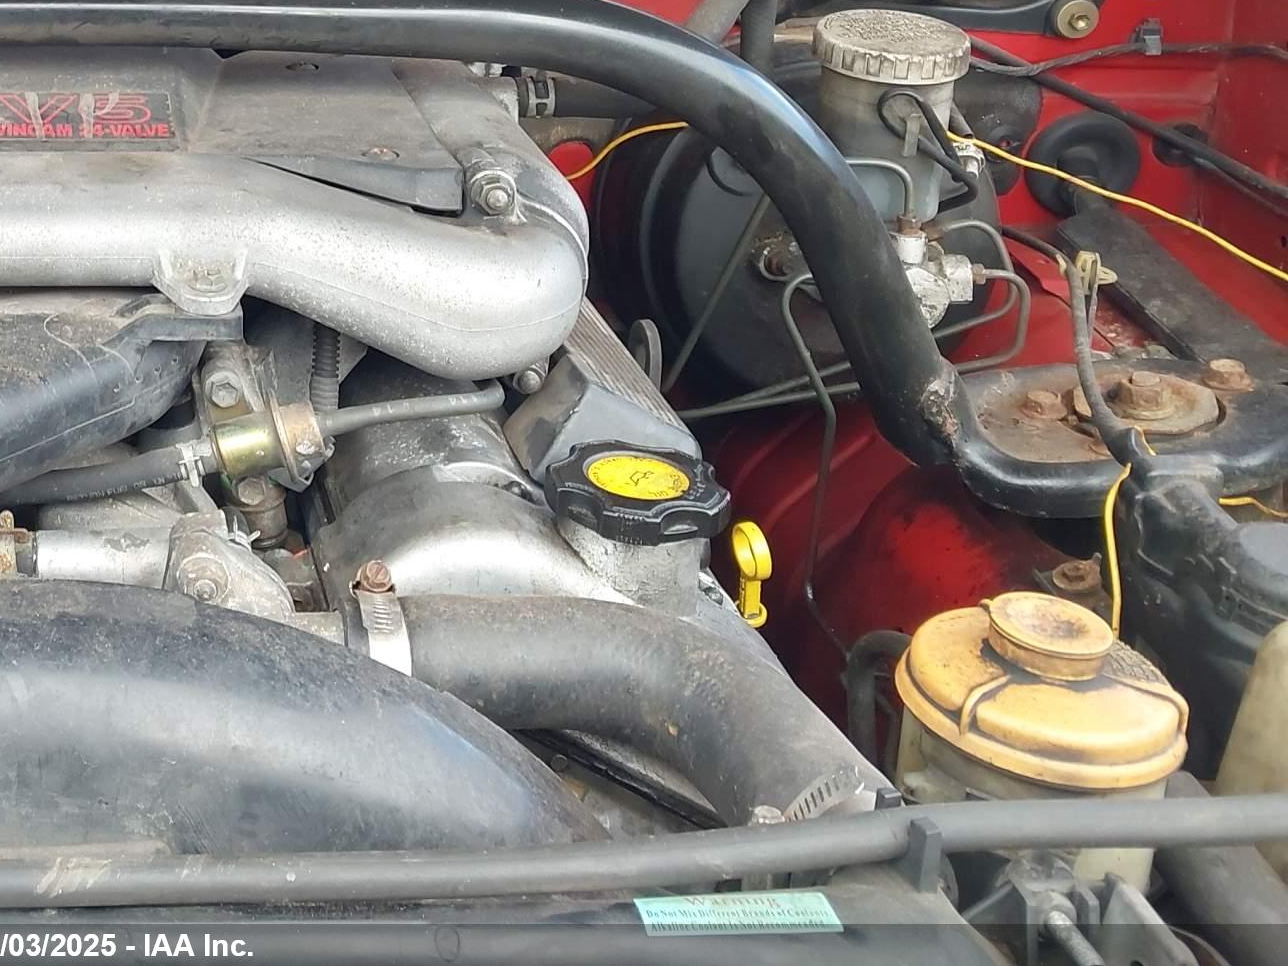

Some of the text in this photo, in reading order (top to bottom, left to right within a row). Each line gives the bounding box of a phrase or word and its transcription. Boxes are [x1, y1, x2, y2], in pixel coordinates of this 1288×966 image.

[684, 897, 781, 909] Warning
[646, 910, 659, 918] Do
[660, 909, 677, 918] Not
[678, 909, 697, 918] Mix
[698, 909, 740, 918] Different
[742, 908, 775, 917] Brands
[651, 921, 689, 932] Alkaline
[691, 921, 728, 931] Coolant
[739, 920, 756, 930] Not
